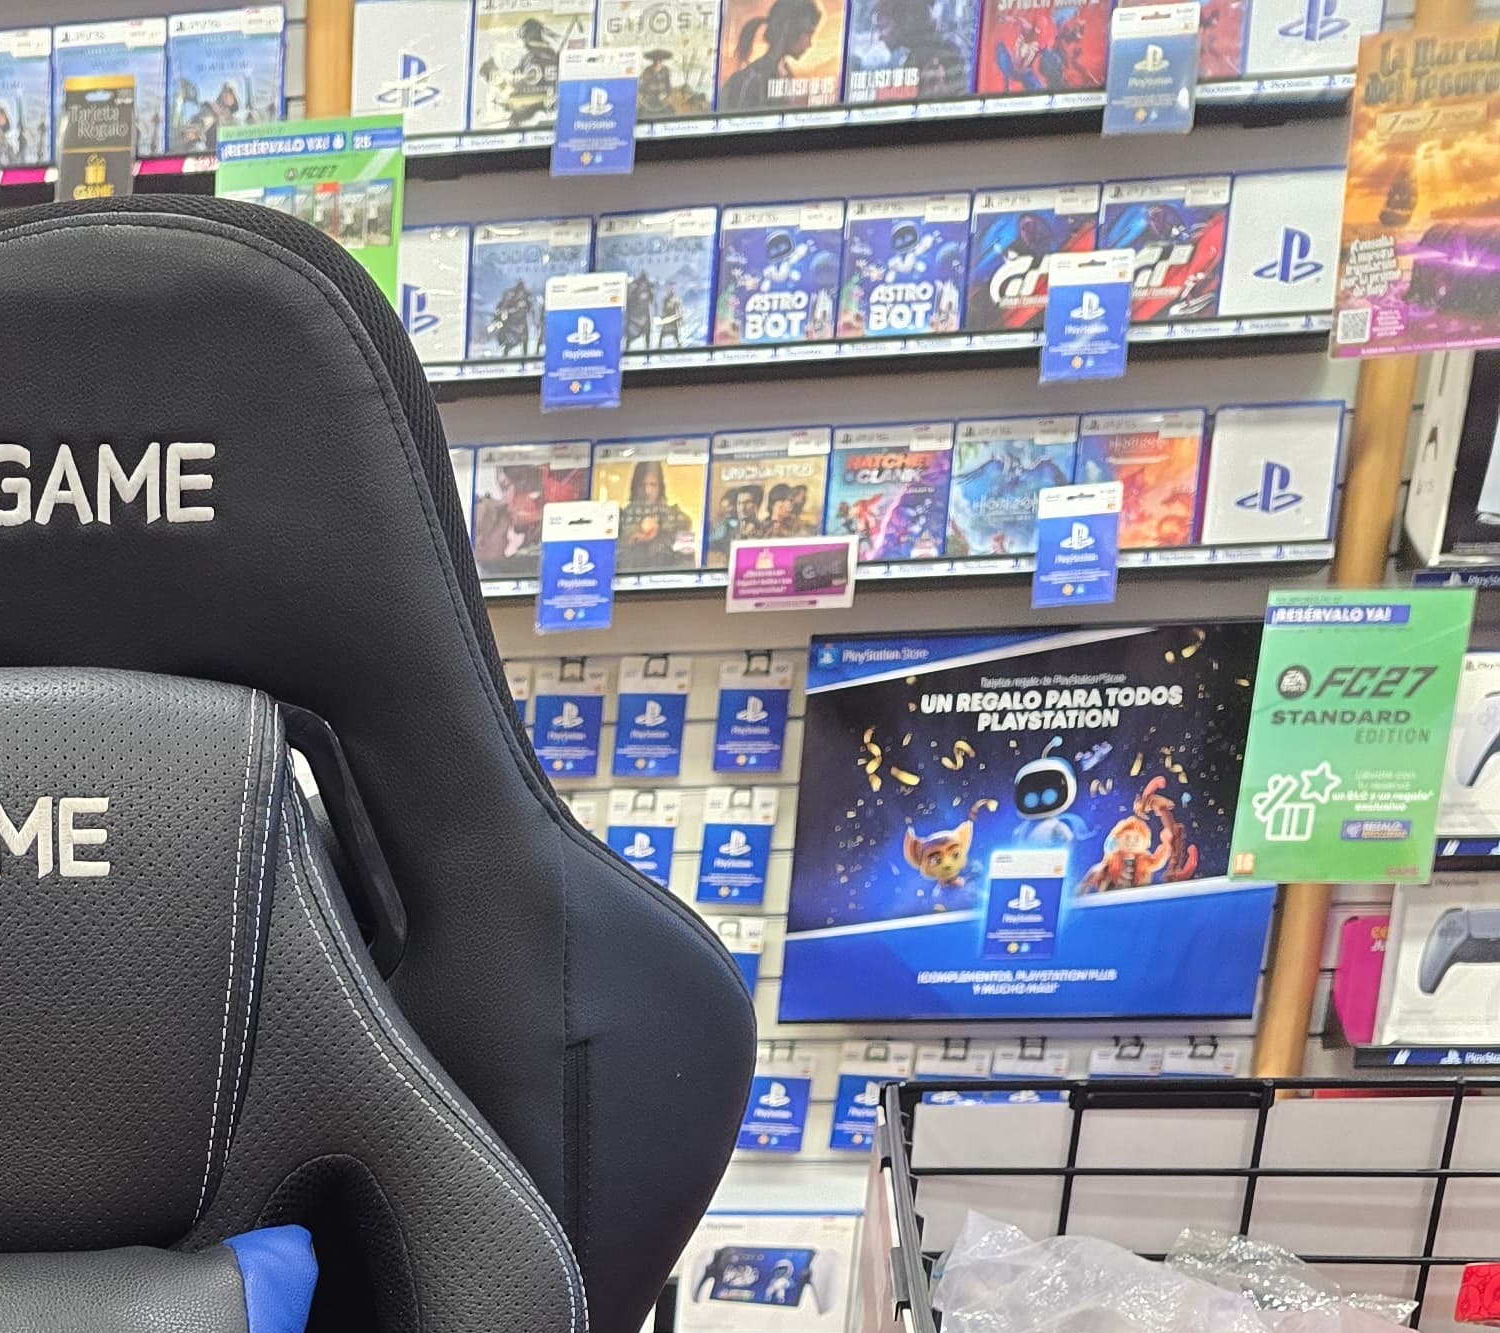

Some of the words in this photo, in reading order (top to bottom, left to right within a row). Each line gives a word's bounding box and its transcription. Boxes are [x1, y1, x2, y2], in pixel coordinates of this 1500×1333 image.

[744, 290, 809, 313] ASTRO
[871, 283, 934, 306] ASTRO
[744, 312, 805, 340] BOT
[869, 305, 933, 331] BOT
[842, 646, 900, 662] PlayStation
[1315, 664, 1439, 699] FC27
[920, 694, 953, 713] UN
[956, 690, 1043, 713] REGALO
[1045, 688, 1103, 709] PARA
[1105, 685, 1184, 706] TODOS
[977, 709, 1120, 732] PLAYSTATION
[1270, 709, 1412, 725] STANDARD
[1355, 727, 1430, 745] EDITION
